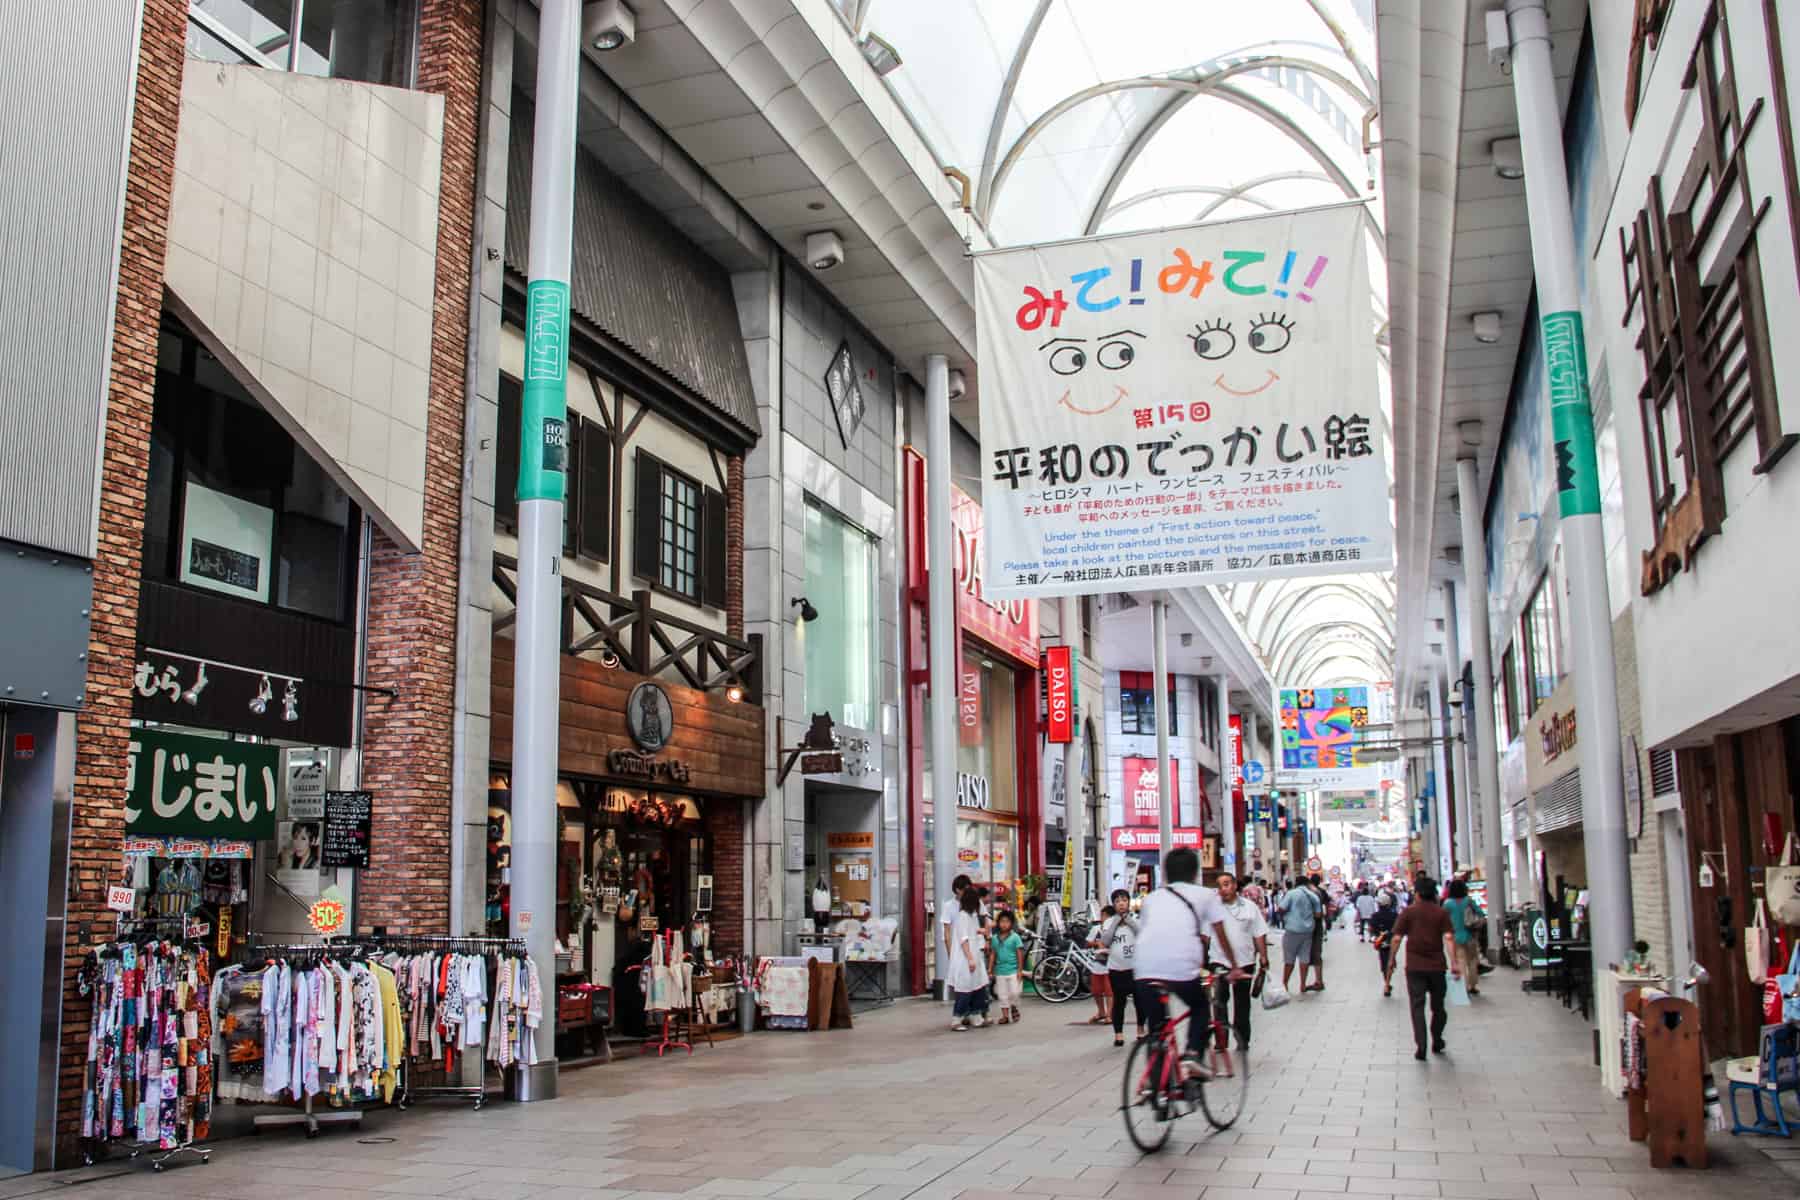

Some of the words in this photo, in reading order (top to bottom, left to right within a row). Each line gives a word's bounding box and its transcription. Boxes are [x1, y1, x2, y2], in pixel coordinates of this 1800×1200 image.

[1133, 401, 1211, 429] 第15回
[992, 414, 1374, 490] 平和のでっかい絵
[1107, 482, 1144, 495] ハート
[1042, 544, 1068, 556] local
[1071, 541, 1114, 553] children
[1117, 539, 1161, 552] painted
[1165, 536, 1184, 546] the
[1187, 530, 1236, 544] pictures
[1240, 530, 1254, 538] on
[1257, 526, 1280, 537] this
[1045, 533, 1077, 543] Under
[1081, 529, 1099, 539] the
[1104, 527, 1139, 538] theme
[1142, 524, 1155, 534] of
[1193, 516, 1231, 530] action
[1234, 514, 1275, 527] toward
[1003, 560, 1040, 571] Please
[1043, 558, 1069, 569] take
[1081, 555, 1105, 566] look
[1108, 554, 1121, 564] at
[1124, 552, 1144, 561] the
[1147, 549, 1195, 562] pictures
[1198, 545, 1220, 556] and
[1224, 542, 1244, 553] the
[1247, 538, 1306, 552] messages
[1308, 536, 1327, 547] for
[1052, 667, 1066, 723] DAISO
[956, 771, 989, 810] AISO
